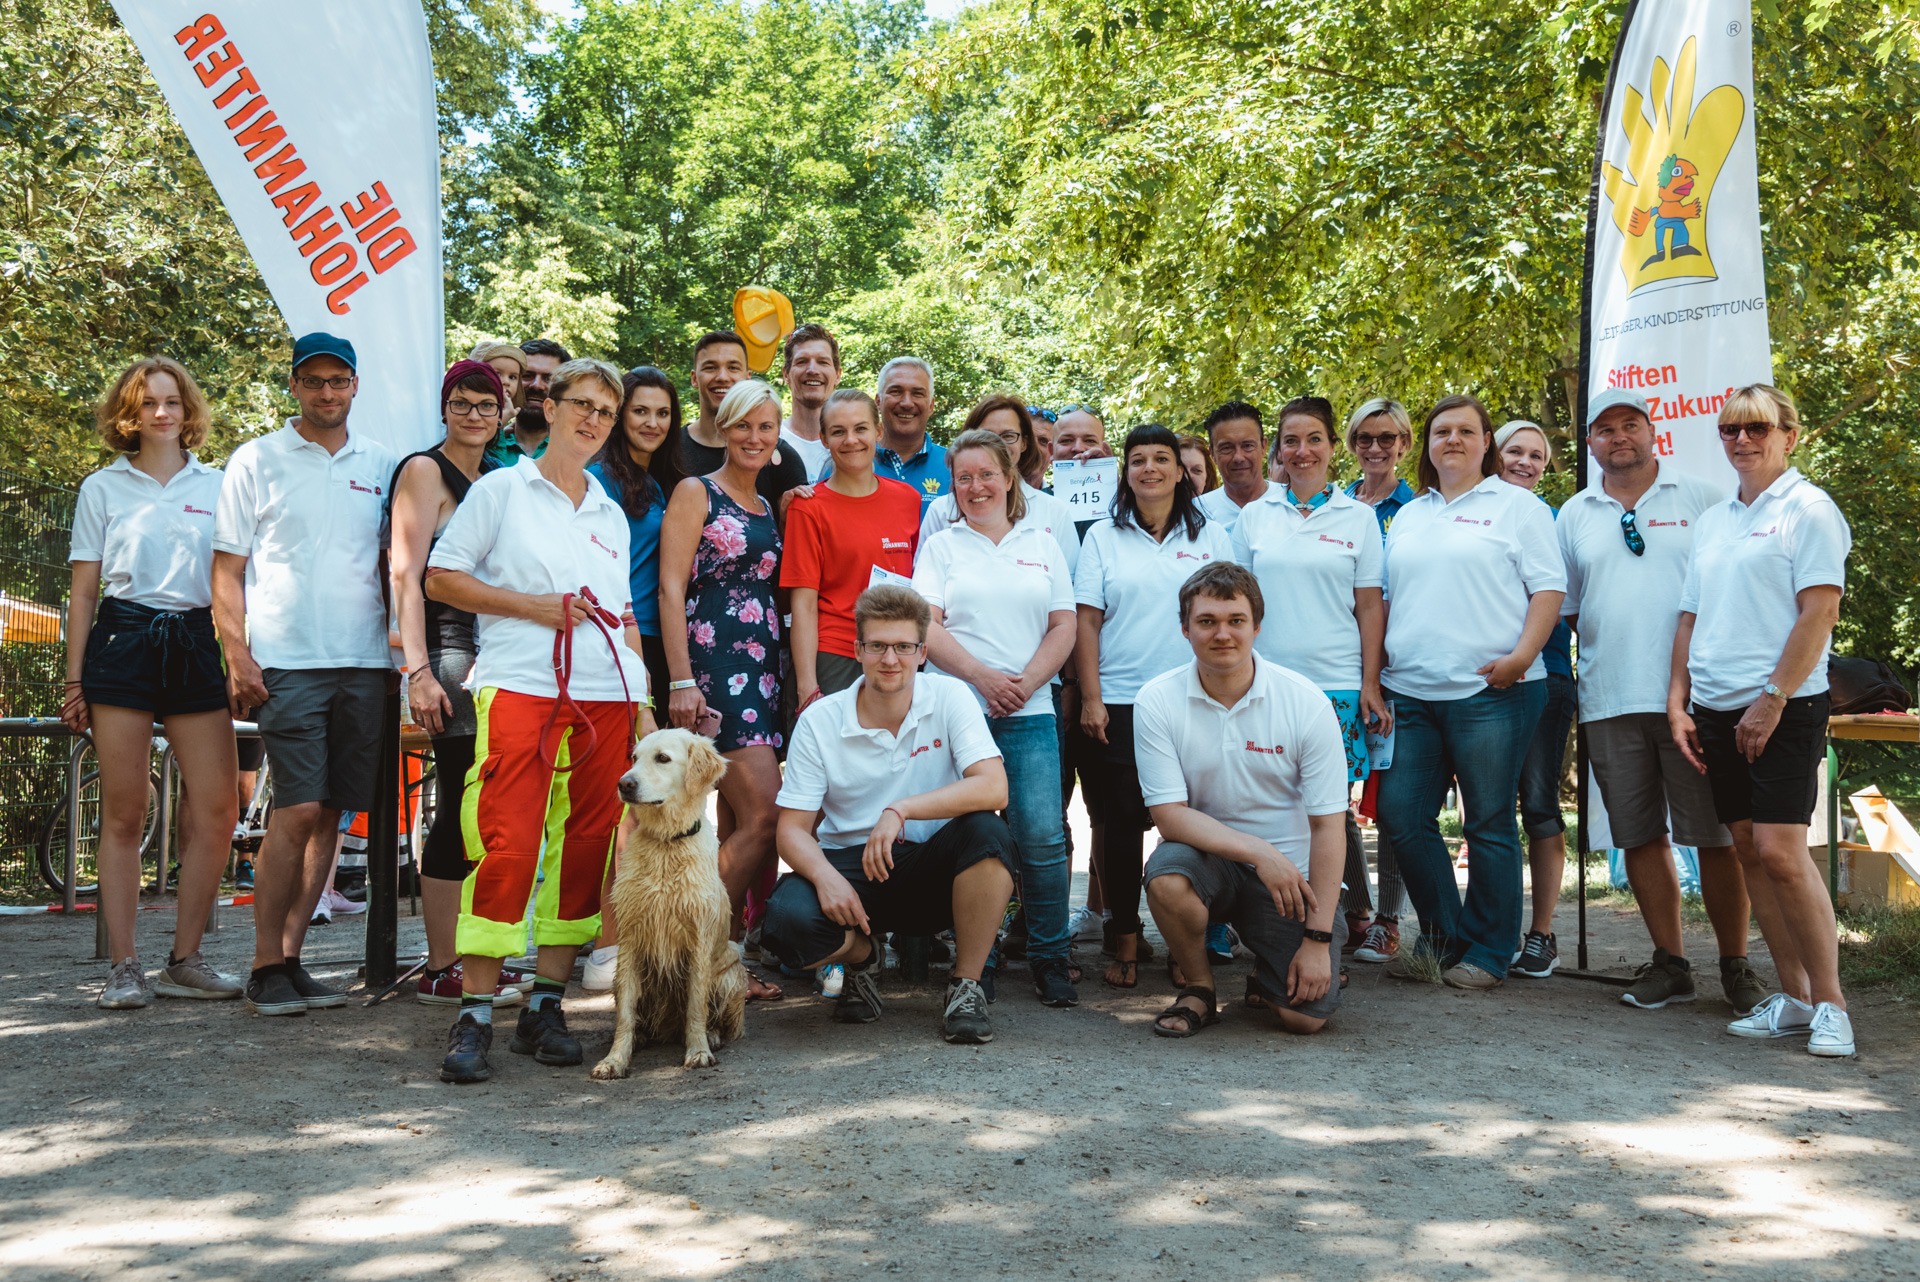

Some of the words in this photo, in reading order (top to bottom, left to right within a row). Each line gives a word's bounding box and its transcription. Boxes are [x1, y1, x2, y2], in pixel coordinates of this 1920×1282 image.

[1643, 296, 1765, 329] KINDERSTIFTUNG
[1607, 364, 1677, 390] Stiften
[1646, 387, 1737, 422] Zukunf
[1070, 491, 1101, 505] 415
[1245, 745, 1274, 754] JOHANNITER
